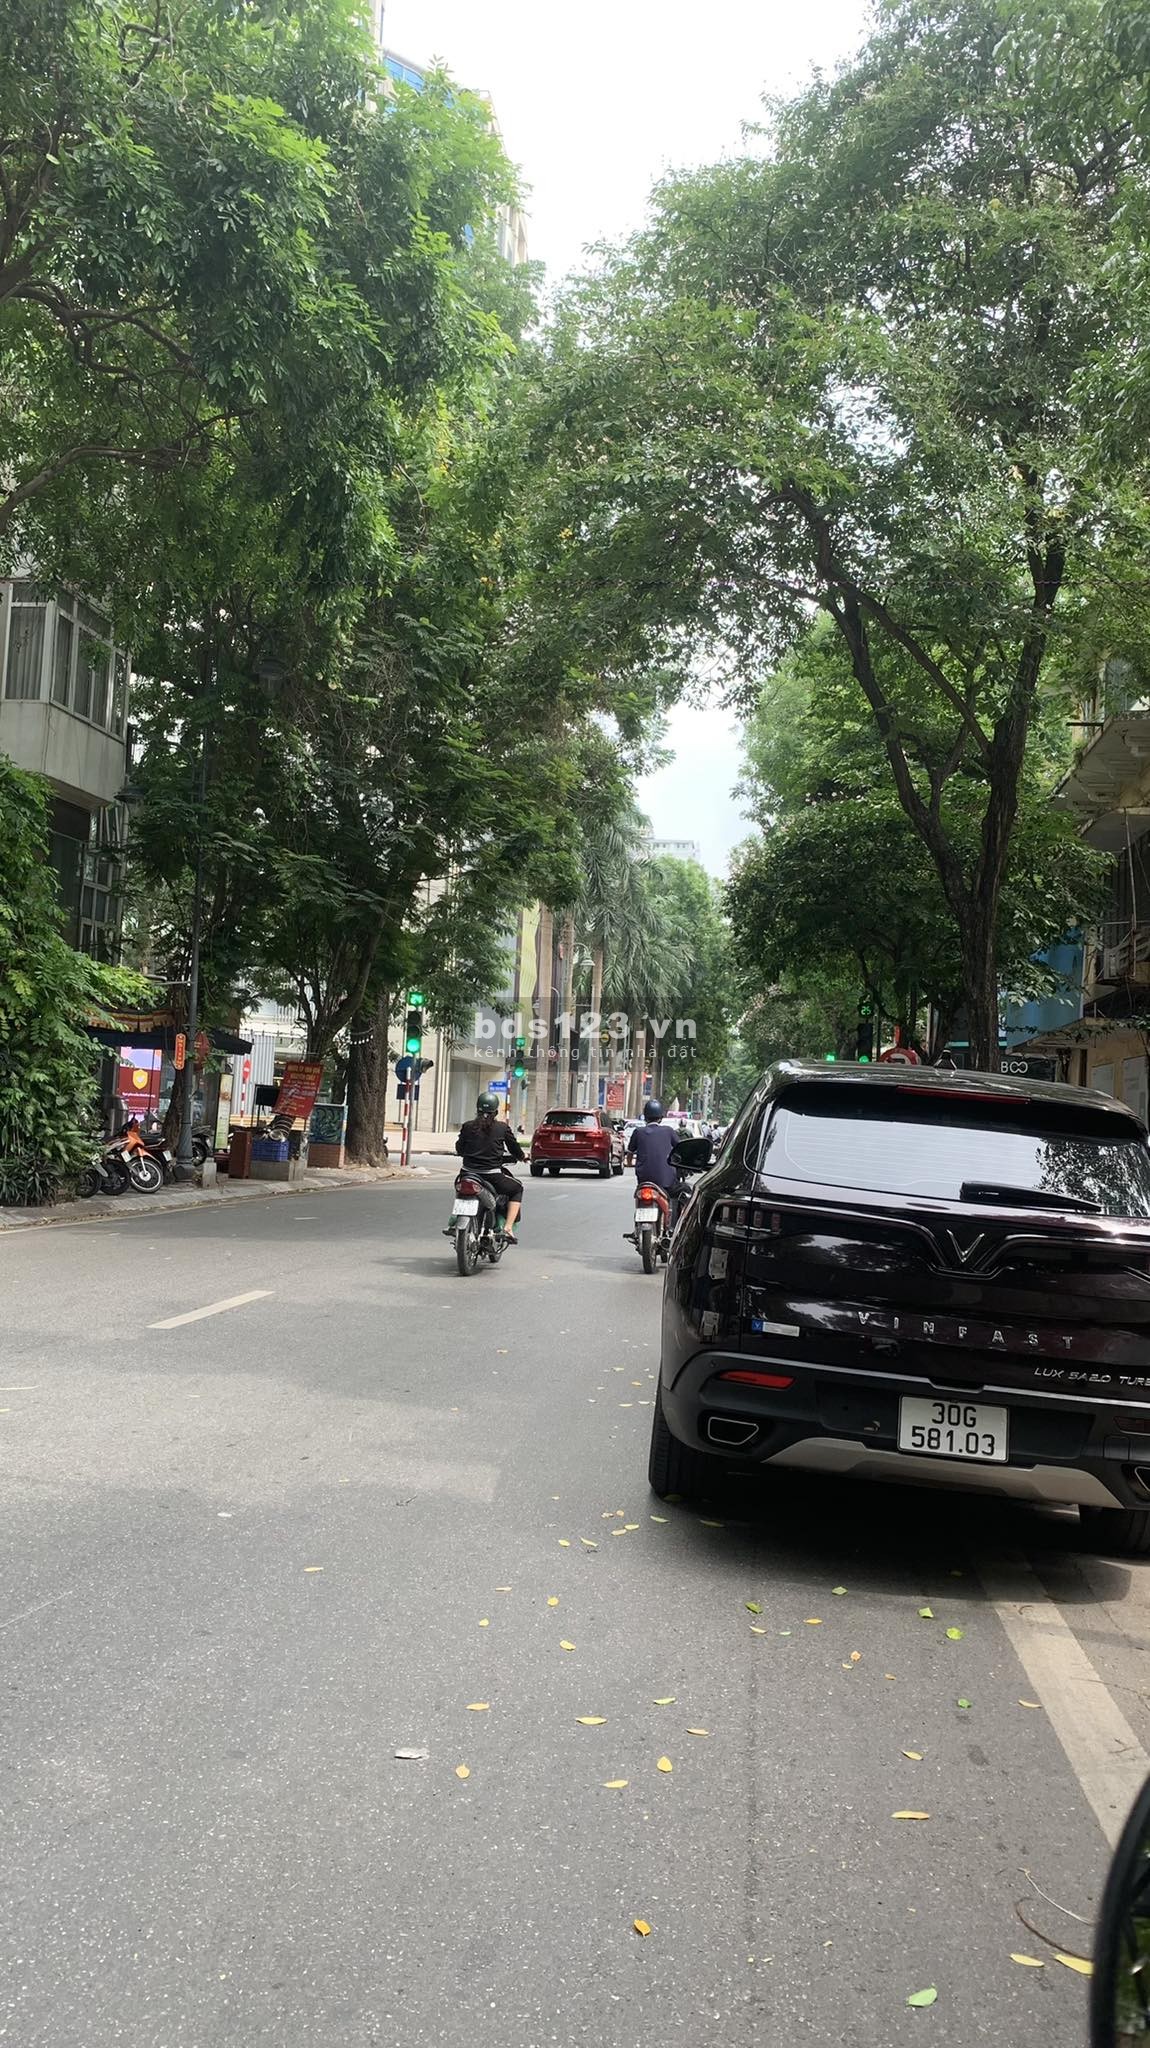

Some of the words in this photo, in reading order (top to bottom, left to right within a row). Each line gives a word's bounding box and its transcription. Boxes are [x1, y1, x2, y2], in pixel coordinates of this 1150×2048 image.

[858, 1311, 1073, 1349] VINFAST
[1034, 1367, 1064, 1378] LUX
[931, 1402, 976, 1428] 30G
[911, 1425, 995, 1456] 581.03
